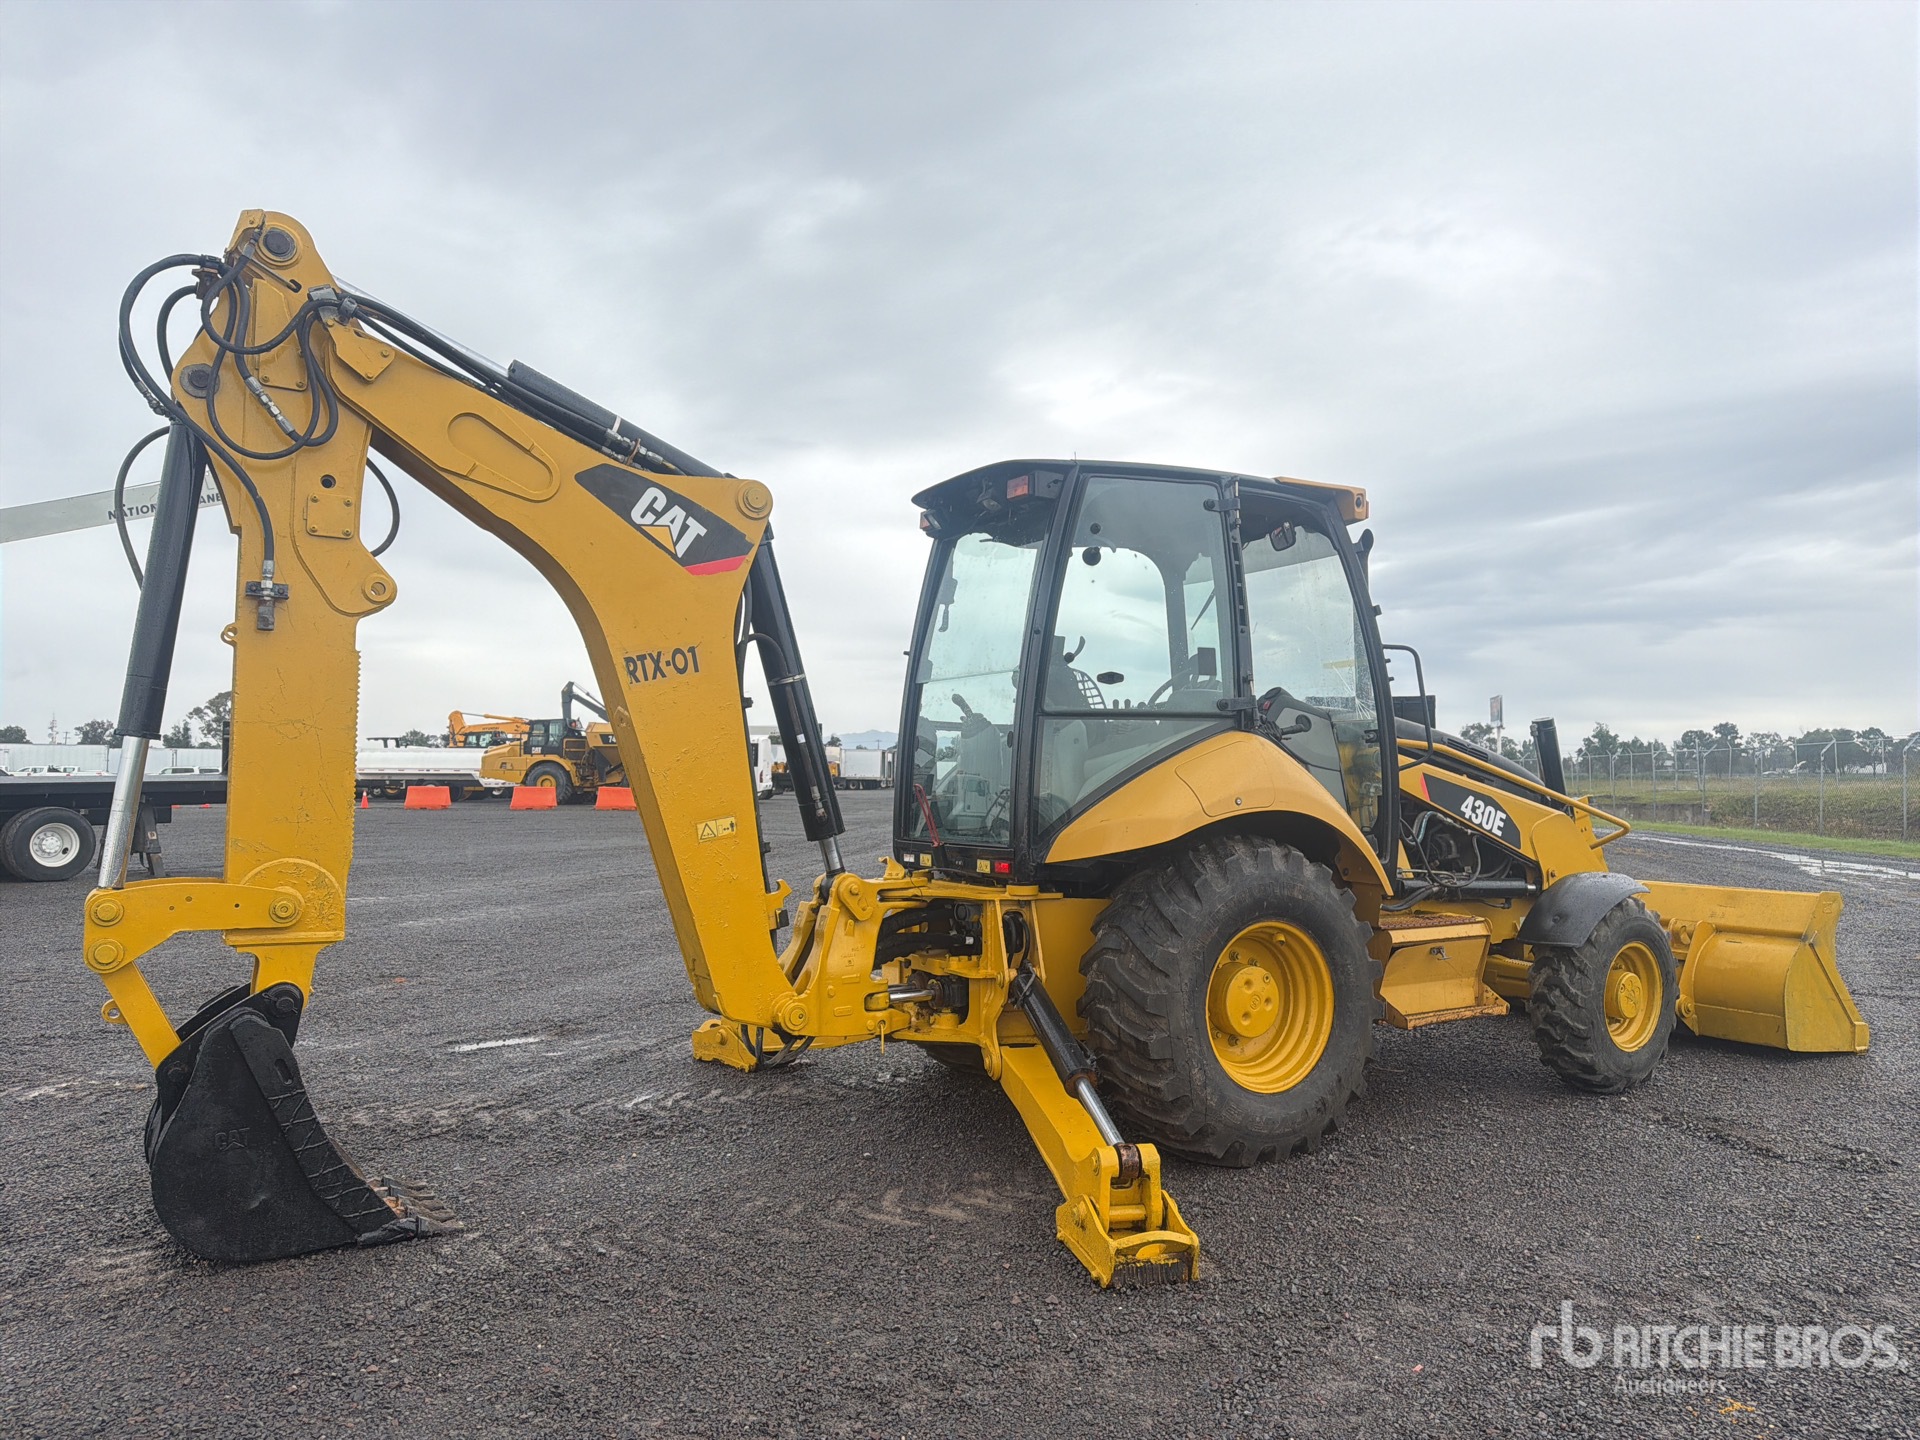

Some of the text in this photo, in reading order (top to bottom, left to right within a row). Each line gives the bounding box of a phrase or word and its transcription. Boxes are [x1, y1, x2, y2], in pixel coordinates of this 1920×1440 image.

[630, 486, 707, 558] CAT
[623, 646, 700, 684] RTX-01
[1460, 795, 1507, 836] 430E
[214, 1127, 250, 1151] CAT
